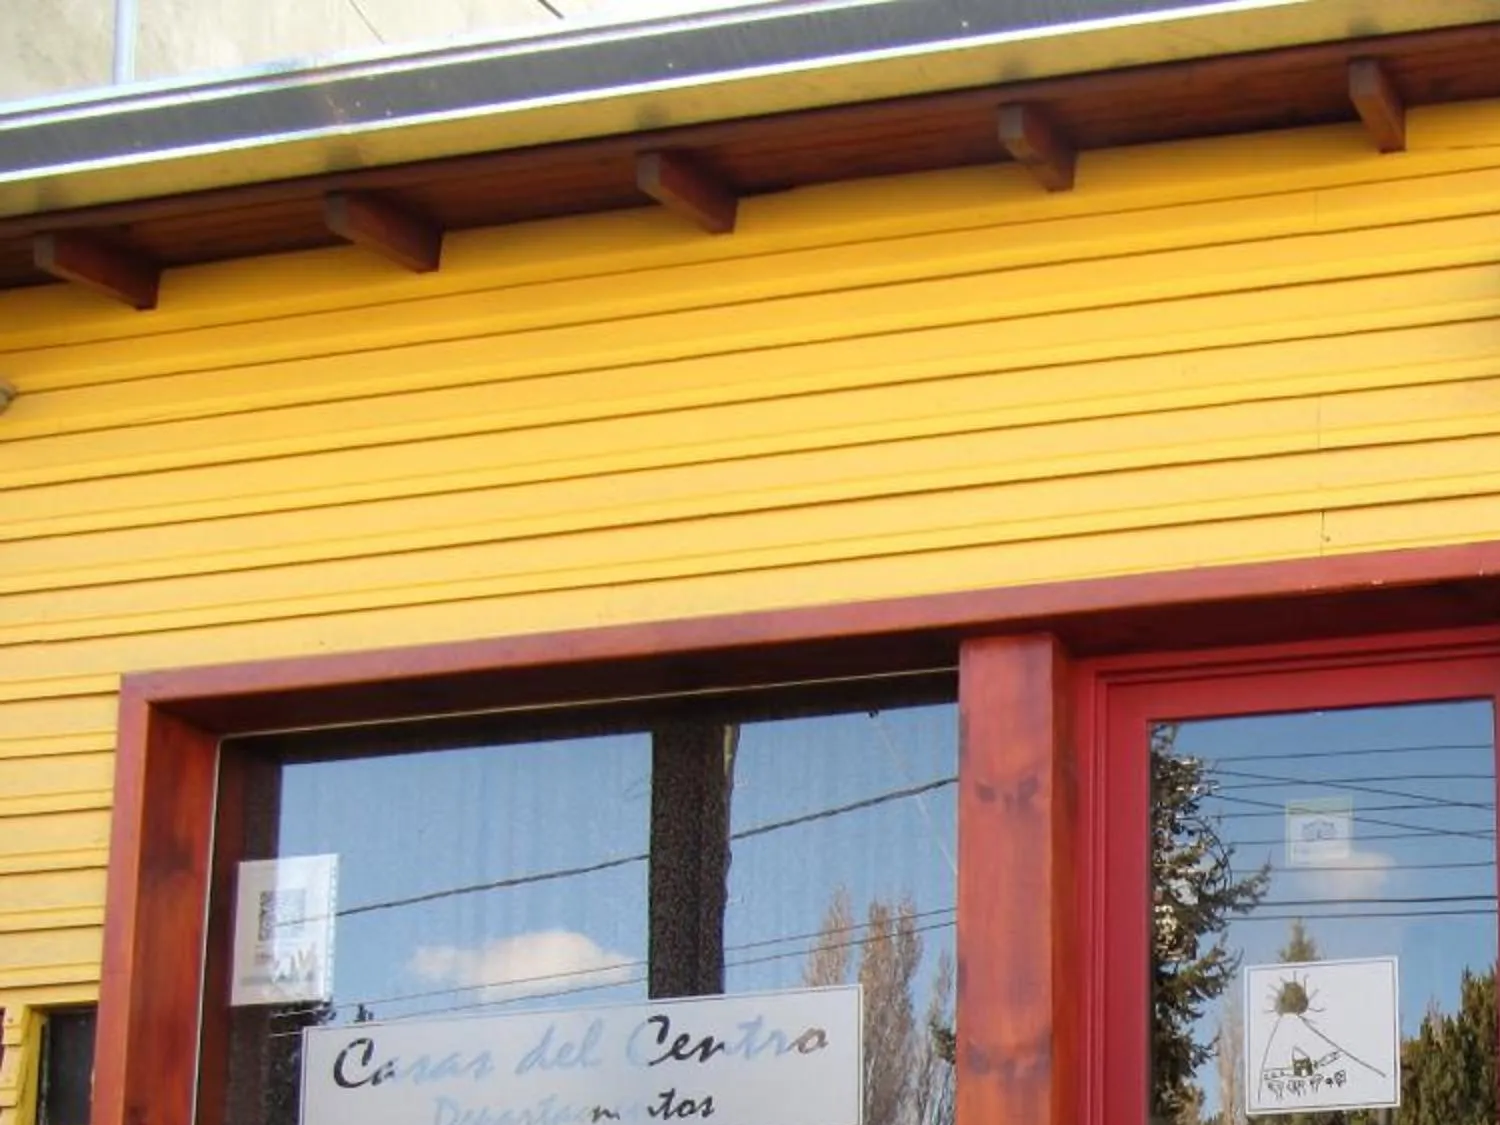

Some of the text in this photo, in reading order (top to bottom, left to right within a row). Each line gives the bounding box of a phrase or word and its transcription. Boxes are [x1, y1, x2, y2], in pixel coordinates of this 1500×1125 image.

[333, 1013, 829, 1090] Casas del Centro
